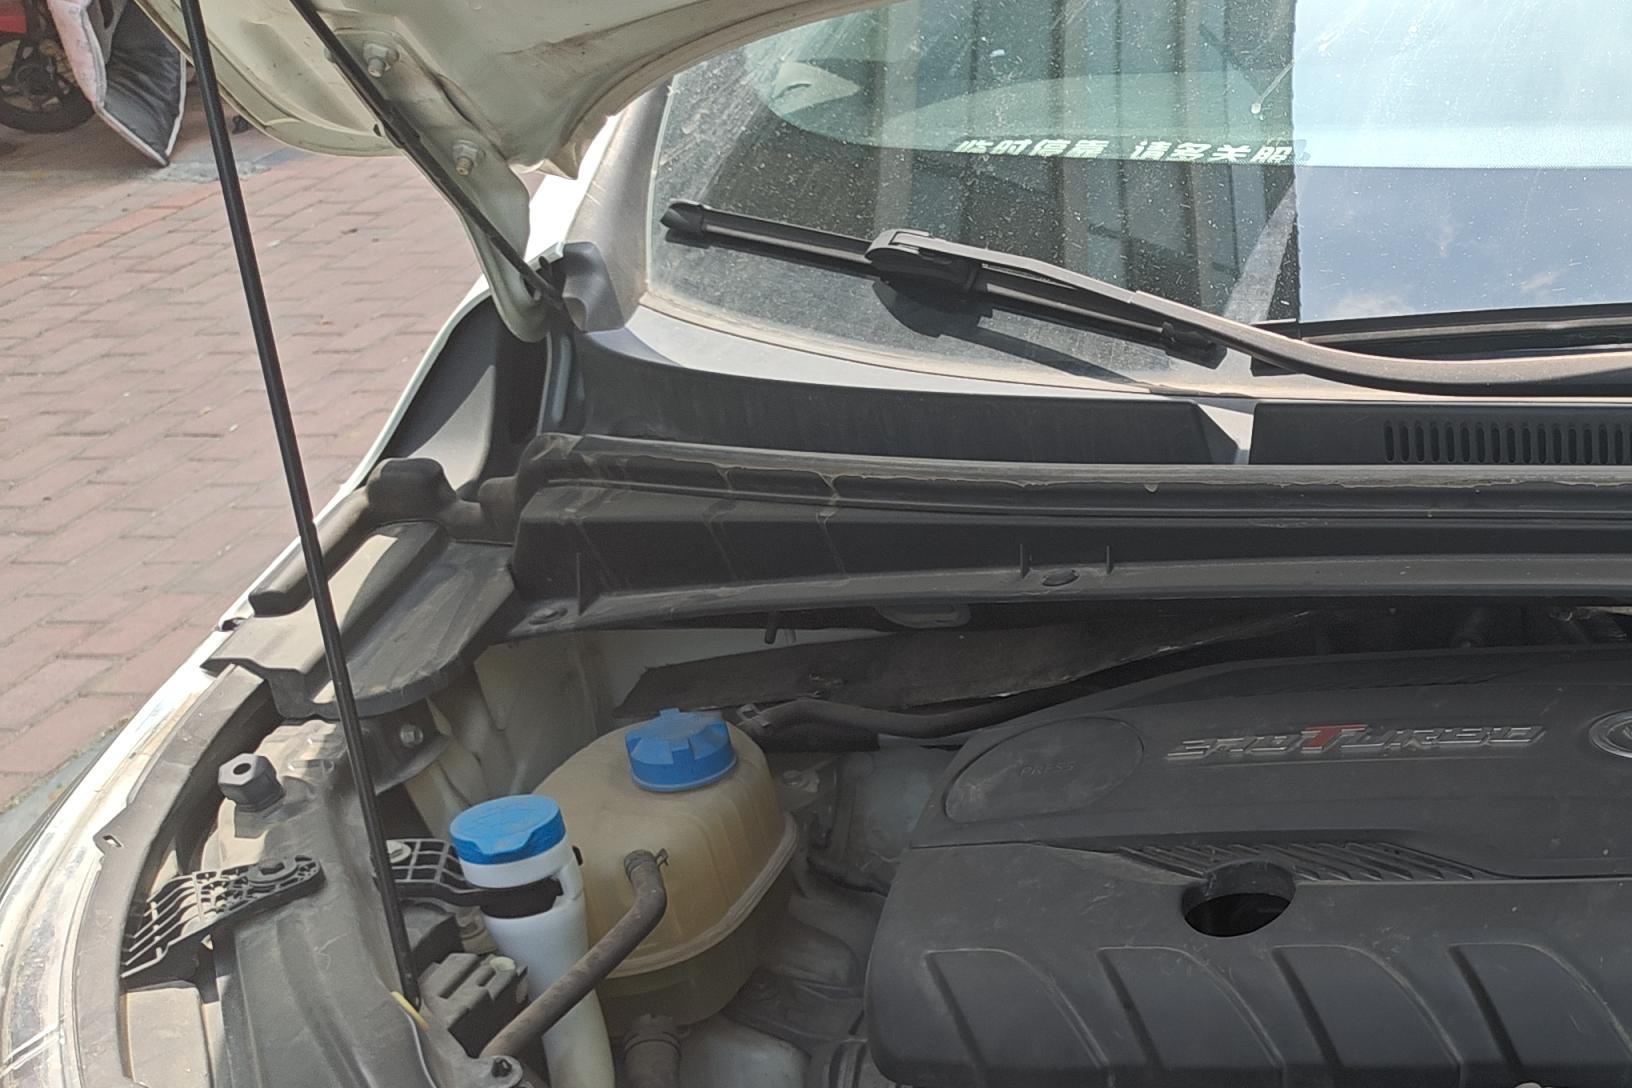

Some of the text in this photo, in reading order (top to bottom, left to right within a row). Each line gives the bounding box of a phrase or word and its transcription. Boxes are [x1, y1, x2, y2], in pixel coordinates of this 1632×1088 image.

[953, 139, 1293, 163] 临时停靠 请多关照
